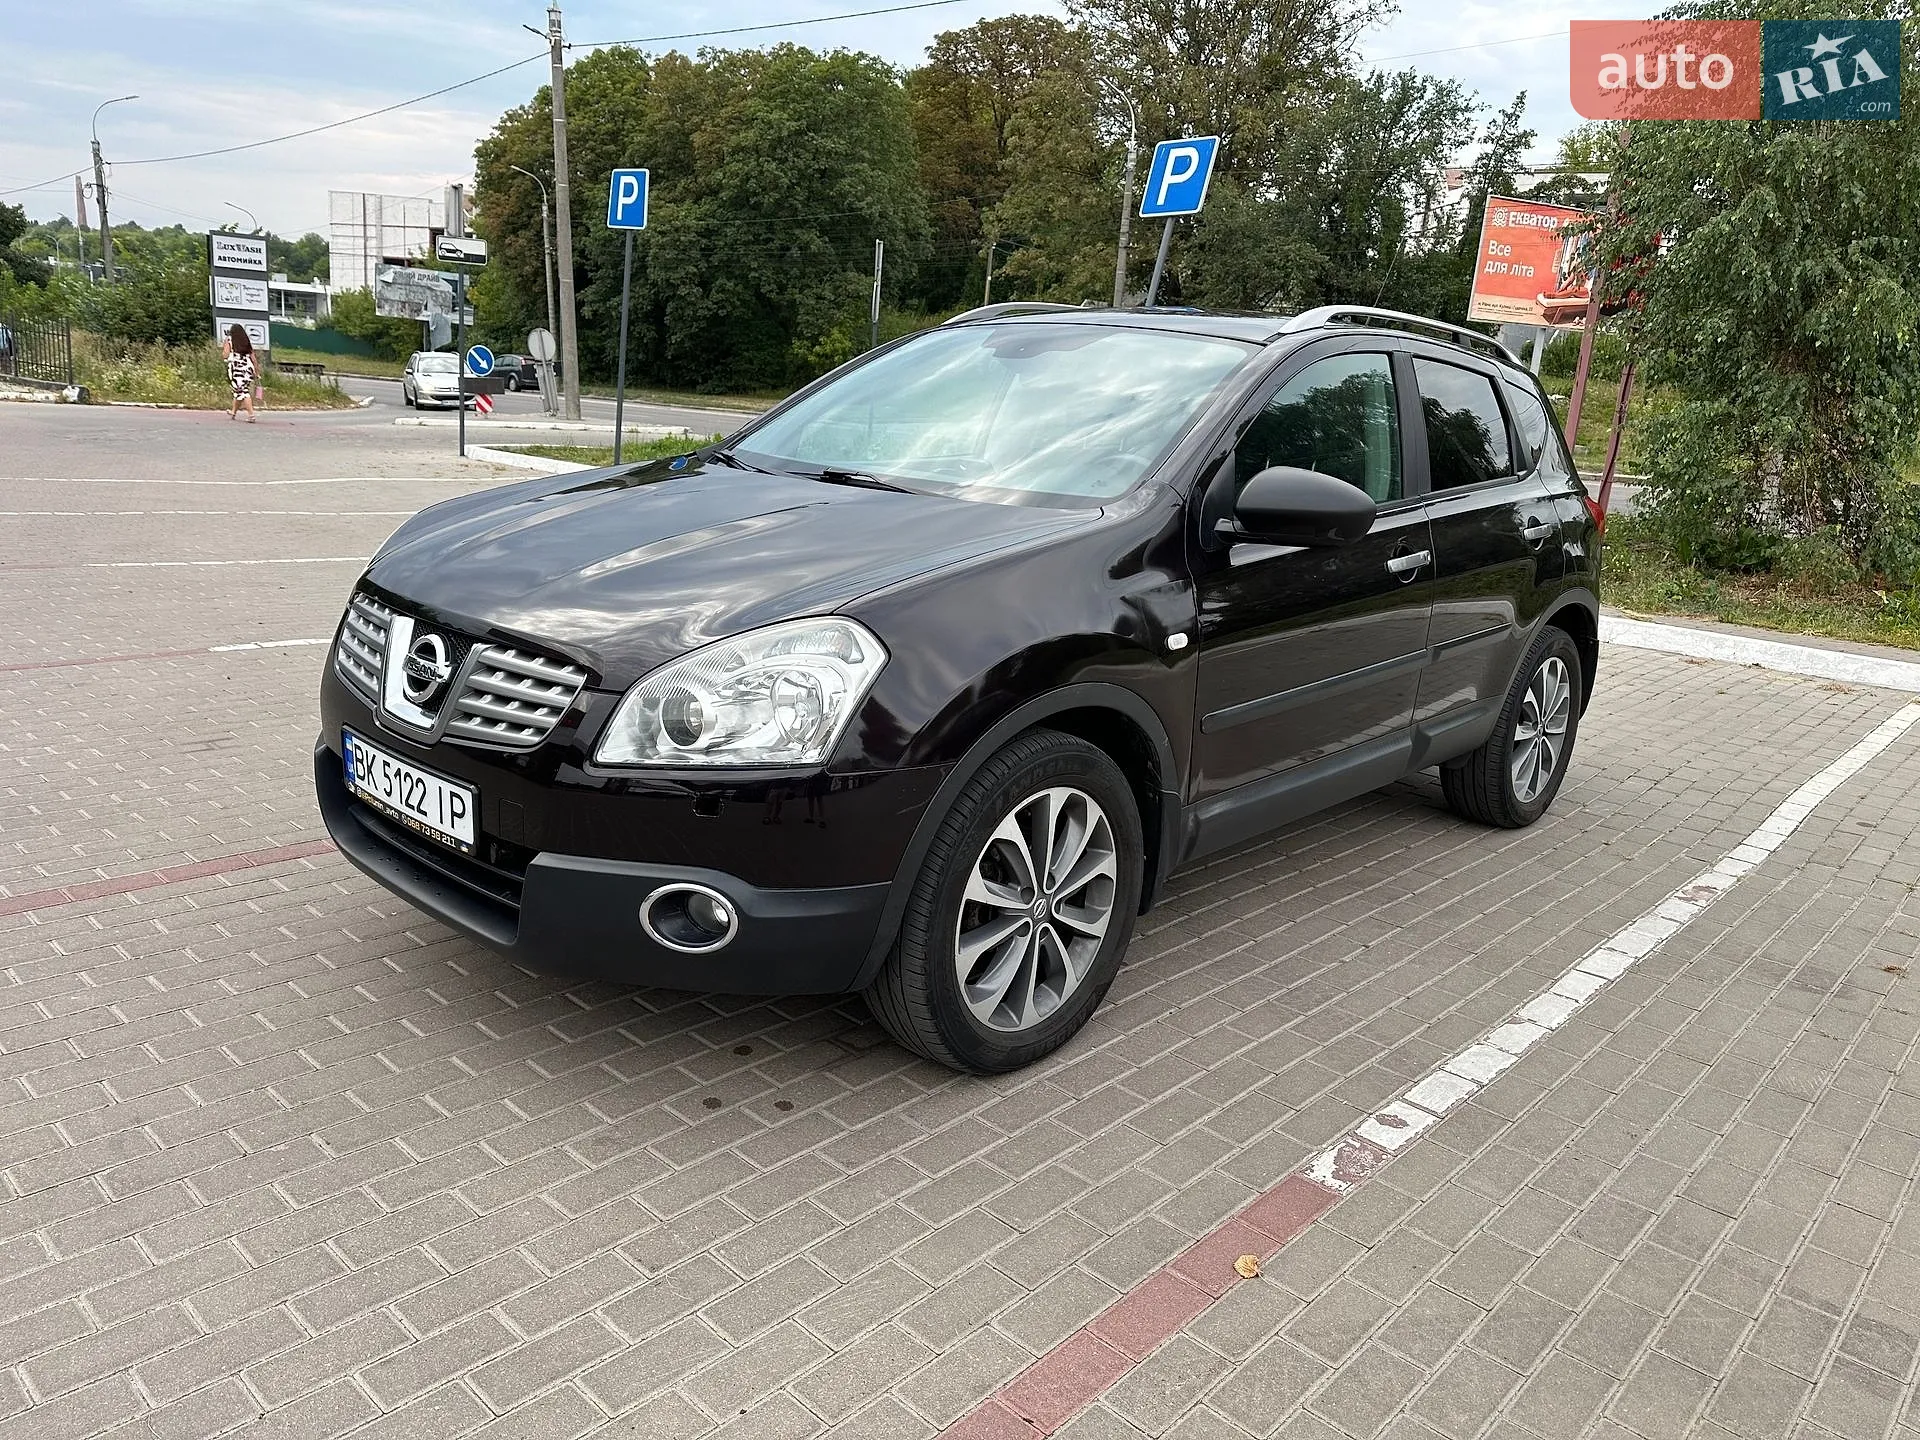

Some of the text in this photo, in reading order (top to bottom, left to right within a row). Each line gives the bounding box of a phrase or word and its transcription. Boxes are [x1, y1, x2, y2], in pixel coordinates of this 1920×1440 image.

[1156, 146, 1200, 206] P
[616, 175, 639, 220] P
[1508, 211, 1558, 231] Екватор
[1488, 240, 1512, 257] Все
[1484, 260, 1535, 278] для літа
[354, 743, 466, 830] BK 5122 IP
